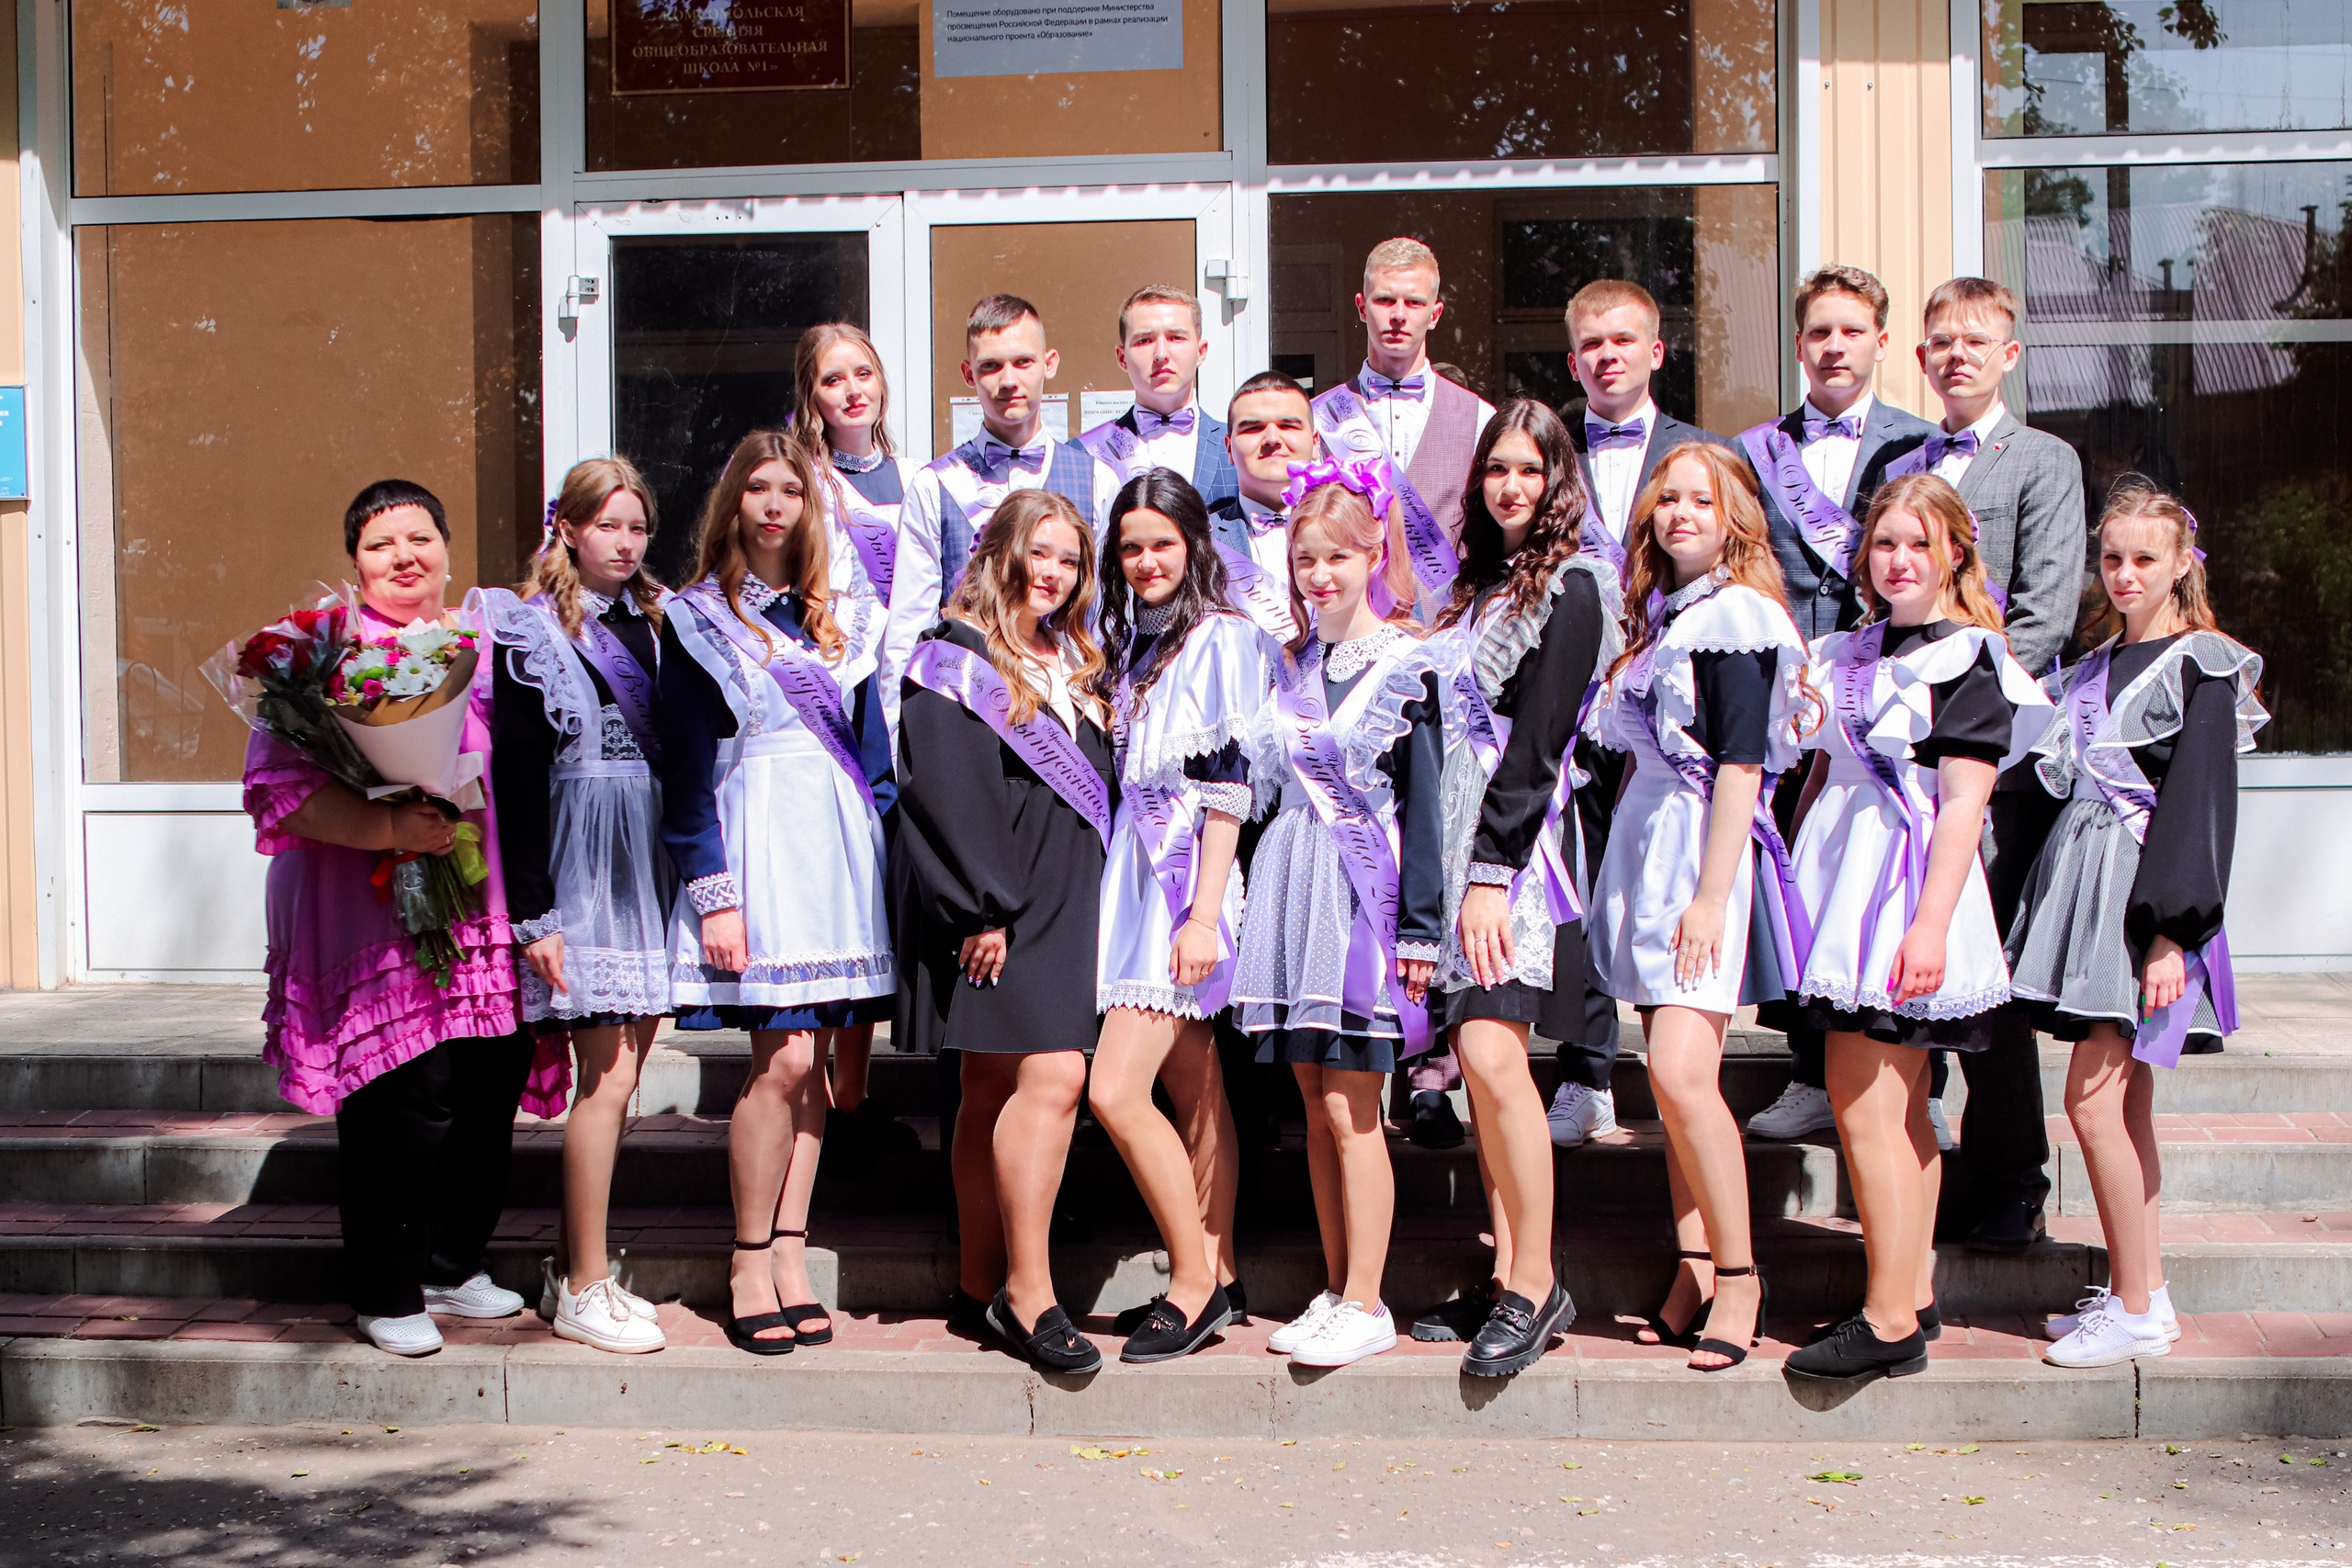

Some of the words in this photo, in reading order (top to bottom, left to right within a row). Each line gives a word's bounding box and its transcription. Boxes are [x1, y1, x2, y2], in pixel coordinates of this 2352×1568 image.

[946, 10, 991, 18] Помещение
[992, 8, 1041, 17] оборудовано
[1042, 7, 1056, 16] при
[1057, 6, 1101, 14] поддержке
[1102, 4, 1155, 12] Министерства
[947, 21, 998, 30] просвещения
[999, 19, 1043, 28] Российской
[1044, 17, 1087, 27] Федерации
[1094, 17, 1121, 26] рамках
[1123, 16, 1168, 24] реализации
[947, 34, 1004, 42] национального
[1005, 32, 1035, 40] проекта
[1036, 30, 1093, 39] «Образование»
[632, 40, 828, 58] ОБЩЕОБРАЗОВАТЕЛЬНАЯ
[683, 62, 740, 74] ШКОЛА
[1397, 484, 1427, 520] Крутов
[1420, 518, 1440, 547] Роман
[1777, 465, 1857, 561] Выпуск
[799, 657, 834, 701] Петрова
[1042, 724, 1080, 766] Арискина
